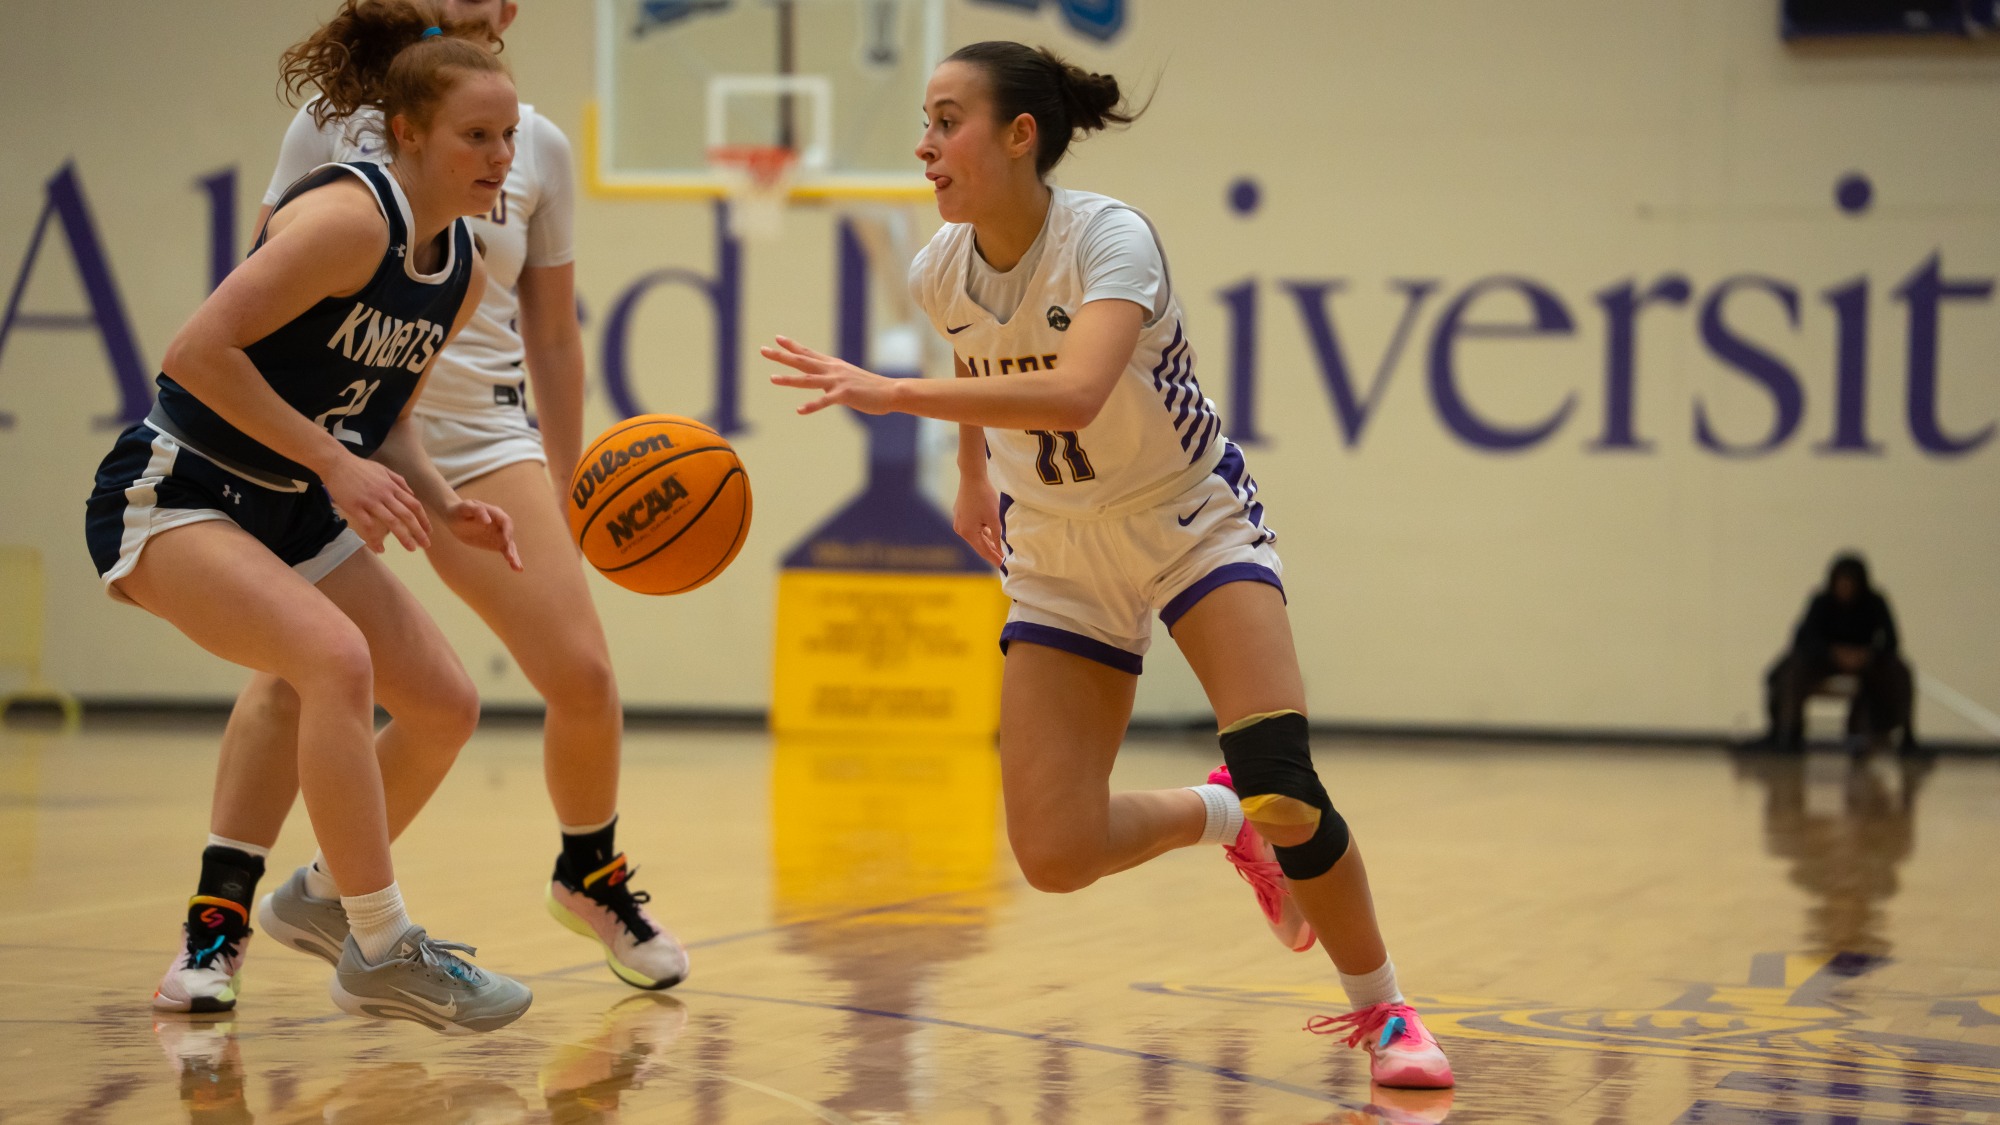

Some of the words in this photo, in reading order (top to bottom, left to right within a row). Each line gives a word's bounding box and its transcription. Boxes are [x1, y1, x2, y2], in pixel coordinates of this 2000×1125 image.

[0, 157, 757, 436] Ald
[838, 172, 1998, 460] iversit
[314, 379, 381, 446] 22
[572, 433, 674, 510] Wilson
[1025, 430, 1096, 485] 11
[606, 475, 689, 548] NCAA
